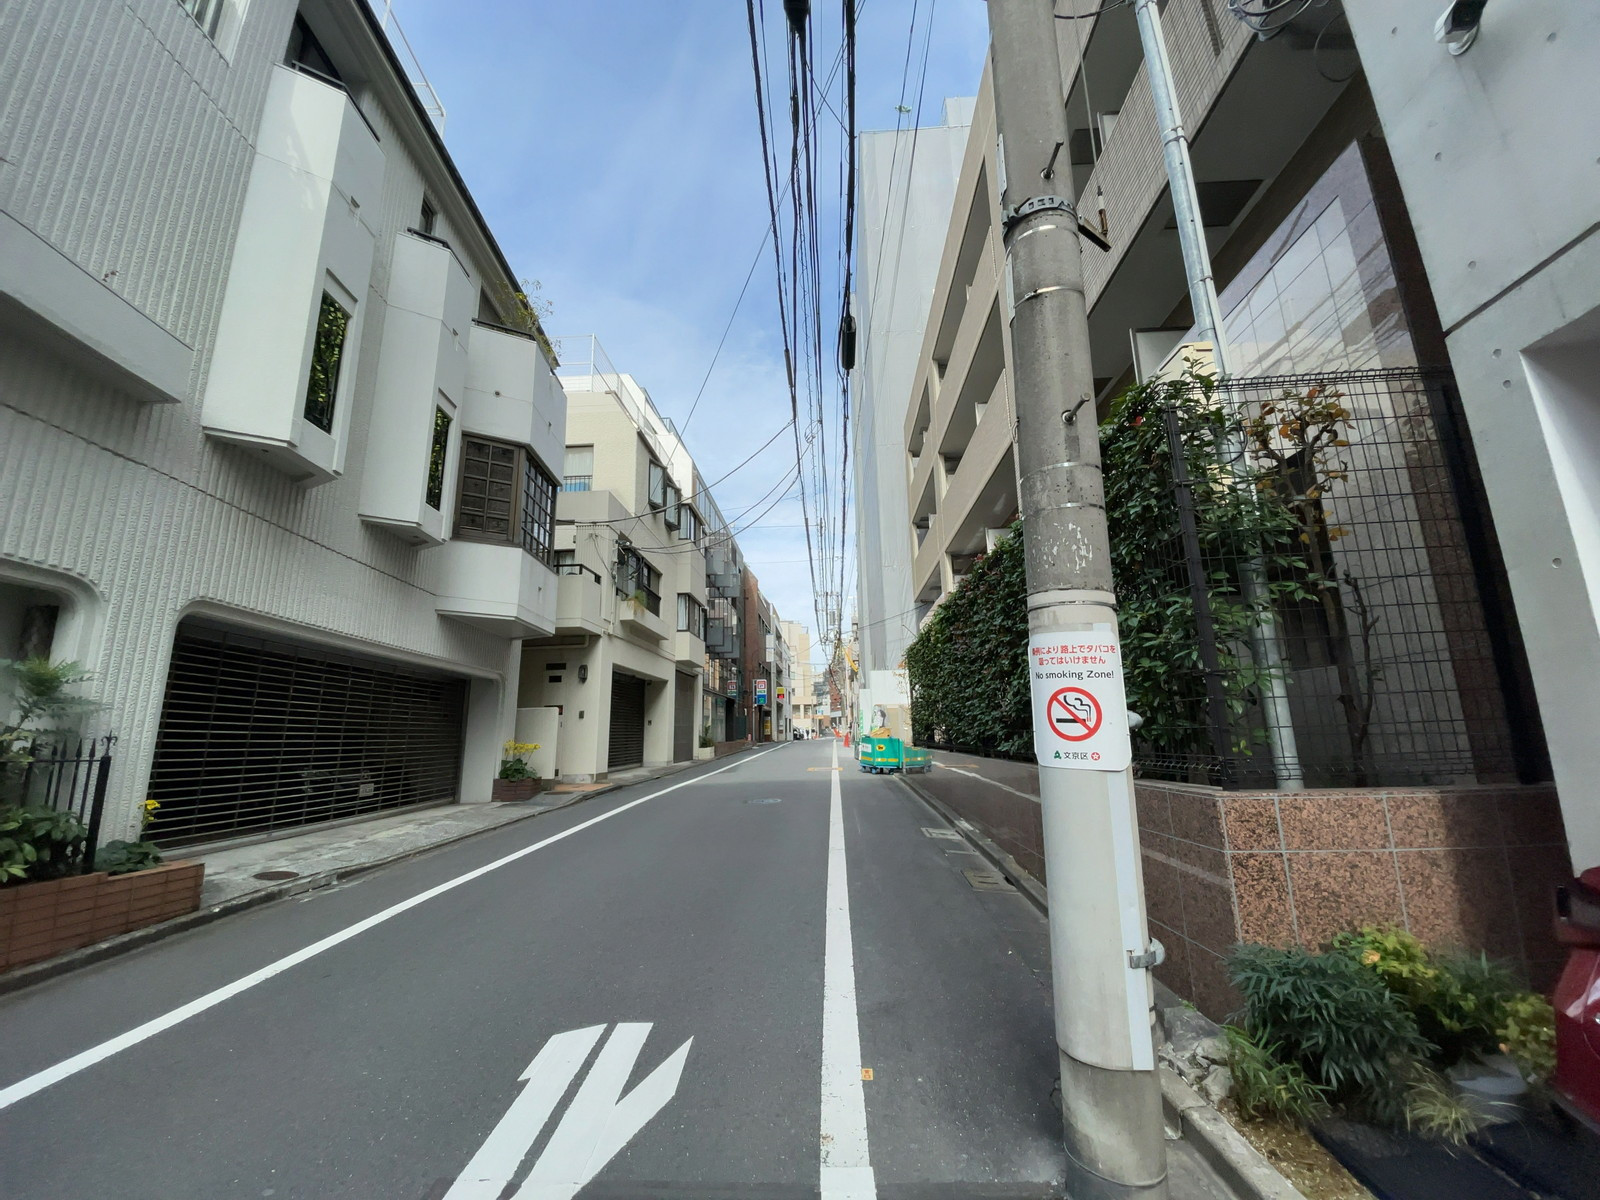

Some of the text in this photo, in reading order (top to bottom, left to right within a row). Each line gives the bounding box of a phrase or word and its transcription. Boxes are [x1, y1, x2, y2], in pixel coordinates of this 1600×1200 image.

[1035, 670, 1114, 680] No smoking Zone!
[1063, 751, 1089, 760] 文京区
